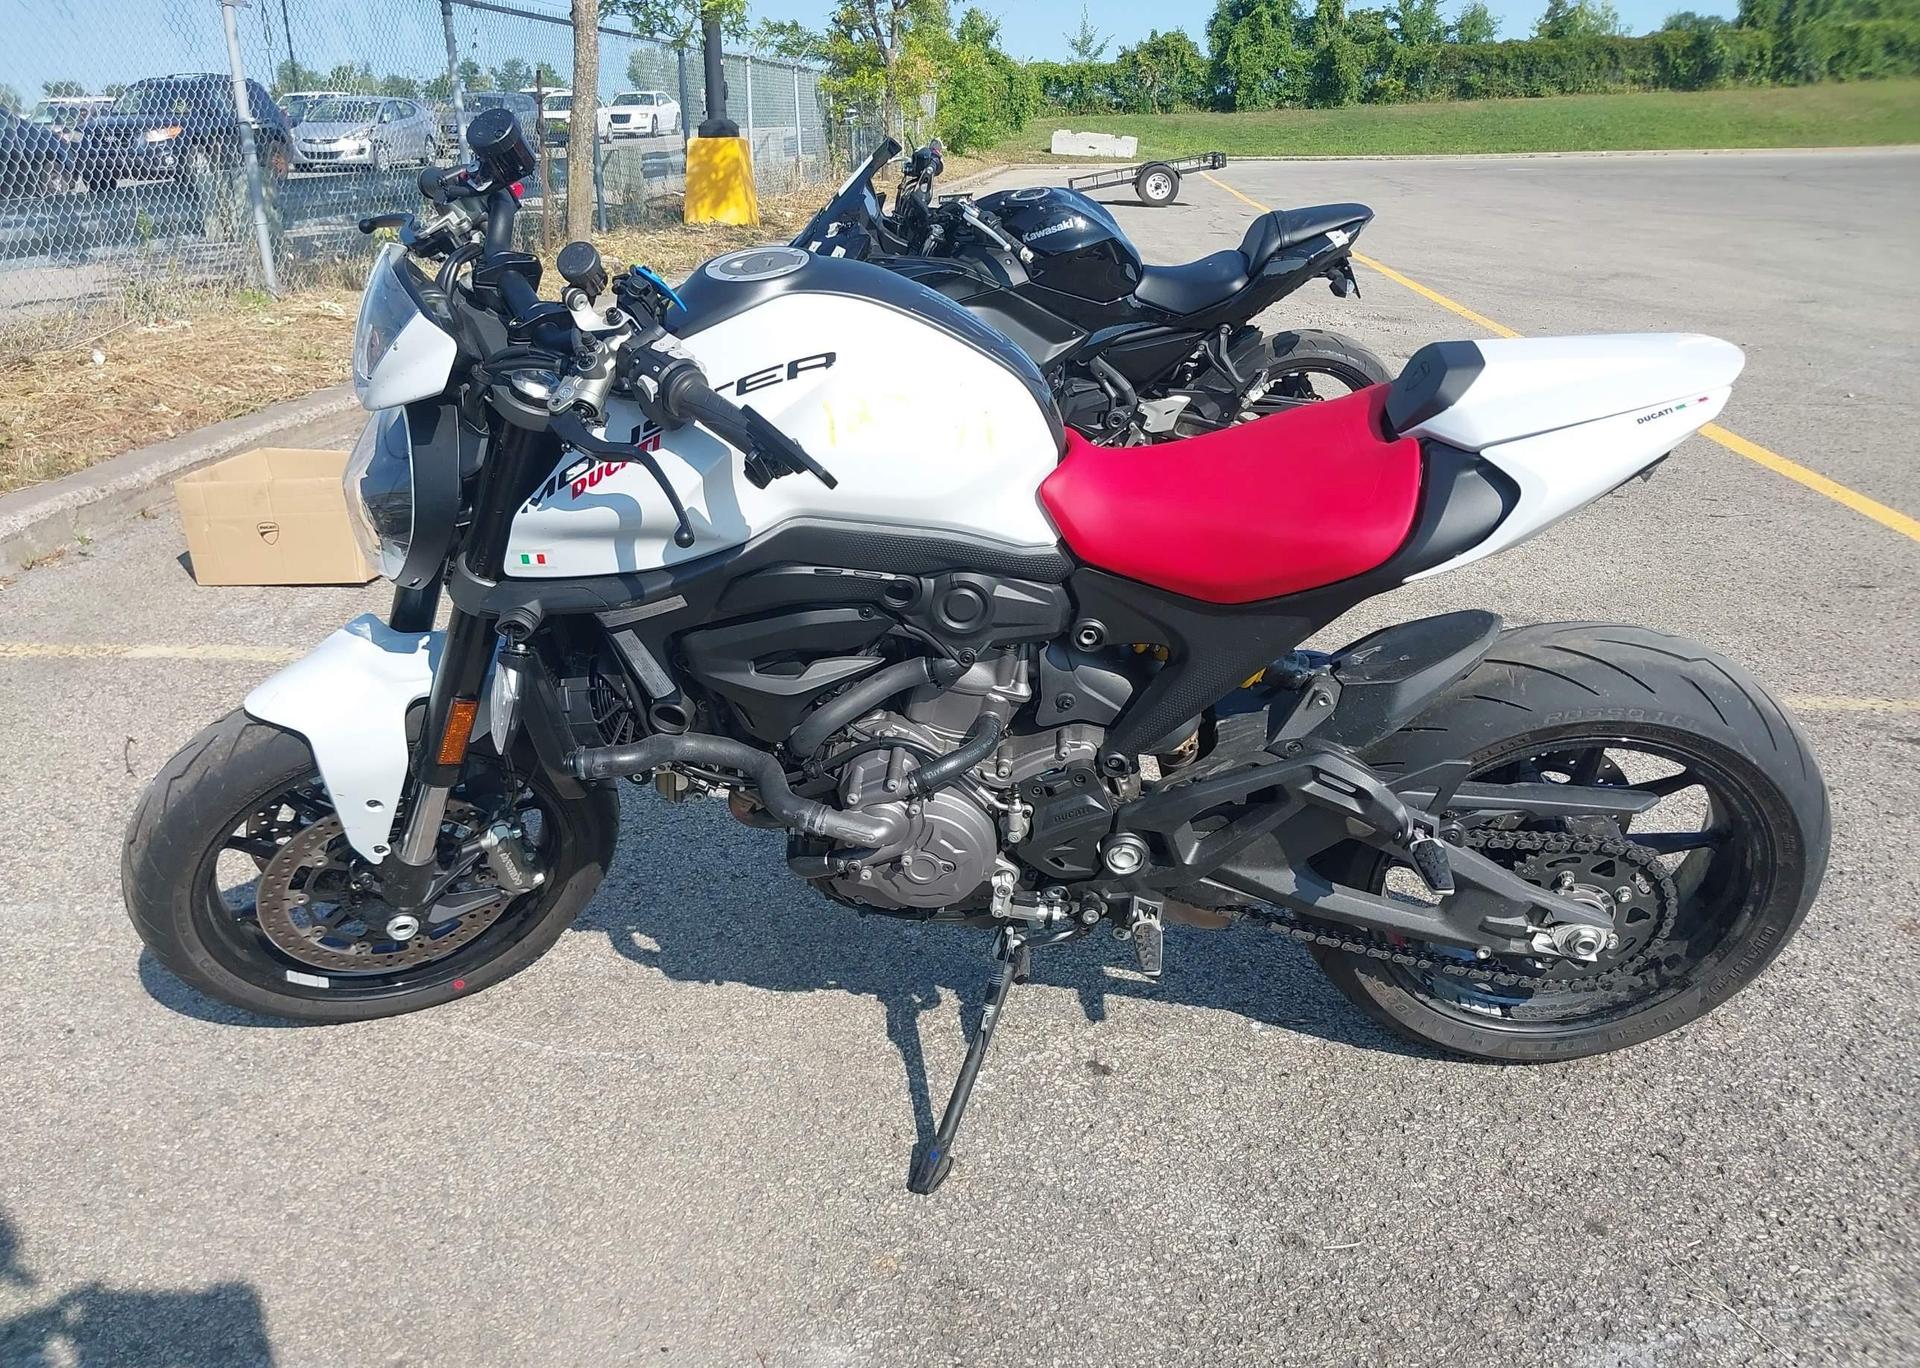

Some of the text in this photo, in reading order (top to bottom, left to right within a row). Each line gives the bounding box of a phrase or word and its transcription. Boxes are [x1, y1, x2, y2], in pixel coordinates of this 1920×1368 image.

[1022, 218, 1075, 243] Kawasaki
[1637, 407, 1674, 425] DUCATI
[571, 434, 661, 500] DUCTI
[1053, 806, 1089, 824] DUCATI
